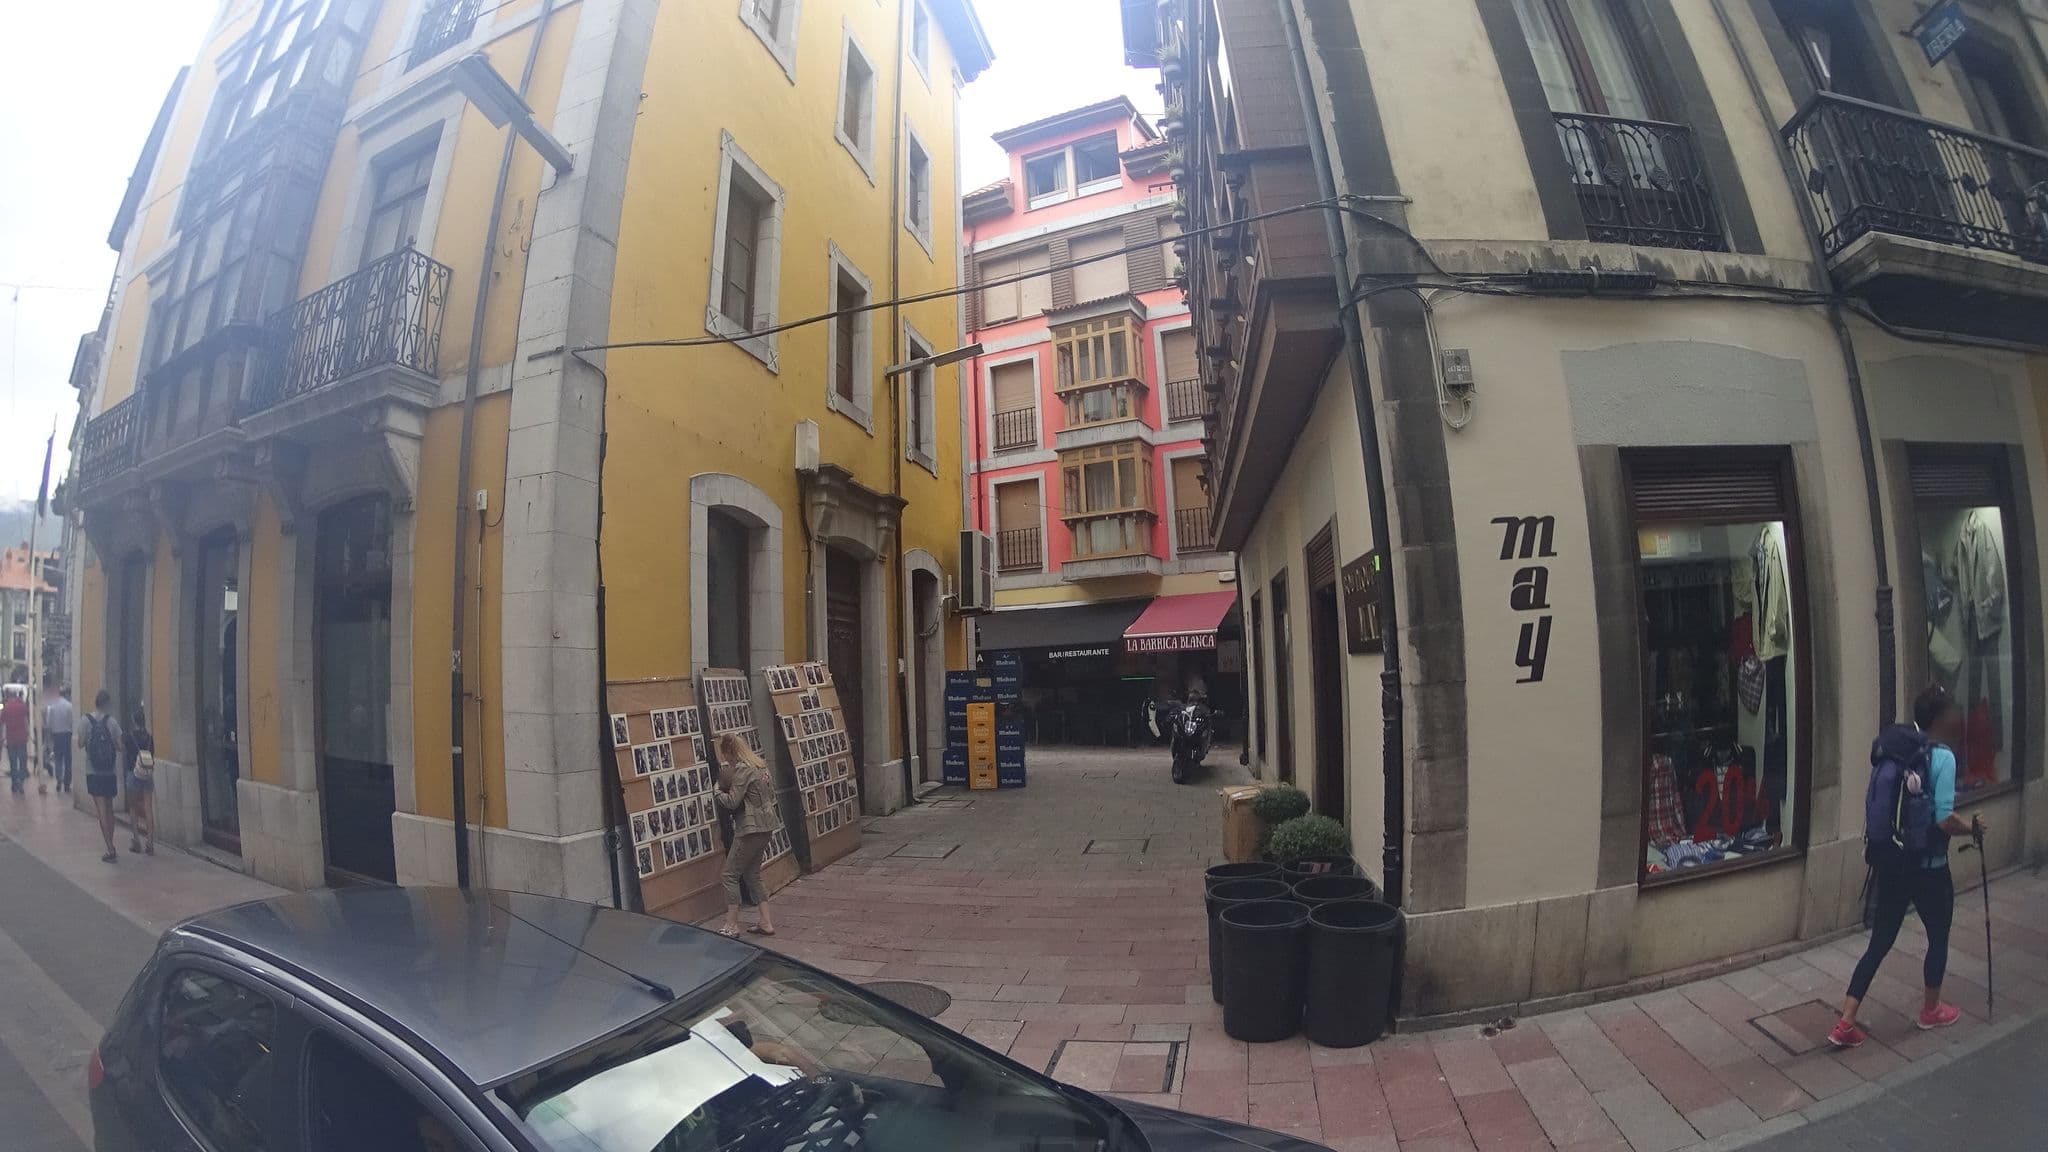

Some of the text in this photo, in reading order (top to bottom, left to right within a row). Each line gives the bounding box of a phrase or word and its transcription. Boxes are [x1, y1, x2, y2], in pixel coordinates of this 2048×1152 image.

[1127, 634, 1215, 652] LA BARRICA BLANCA
